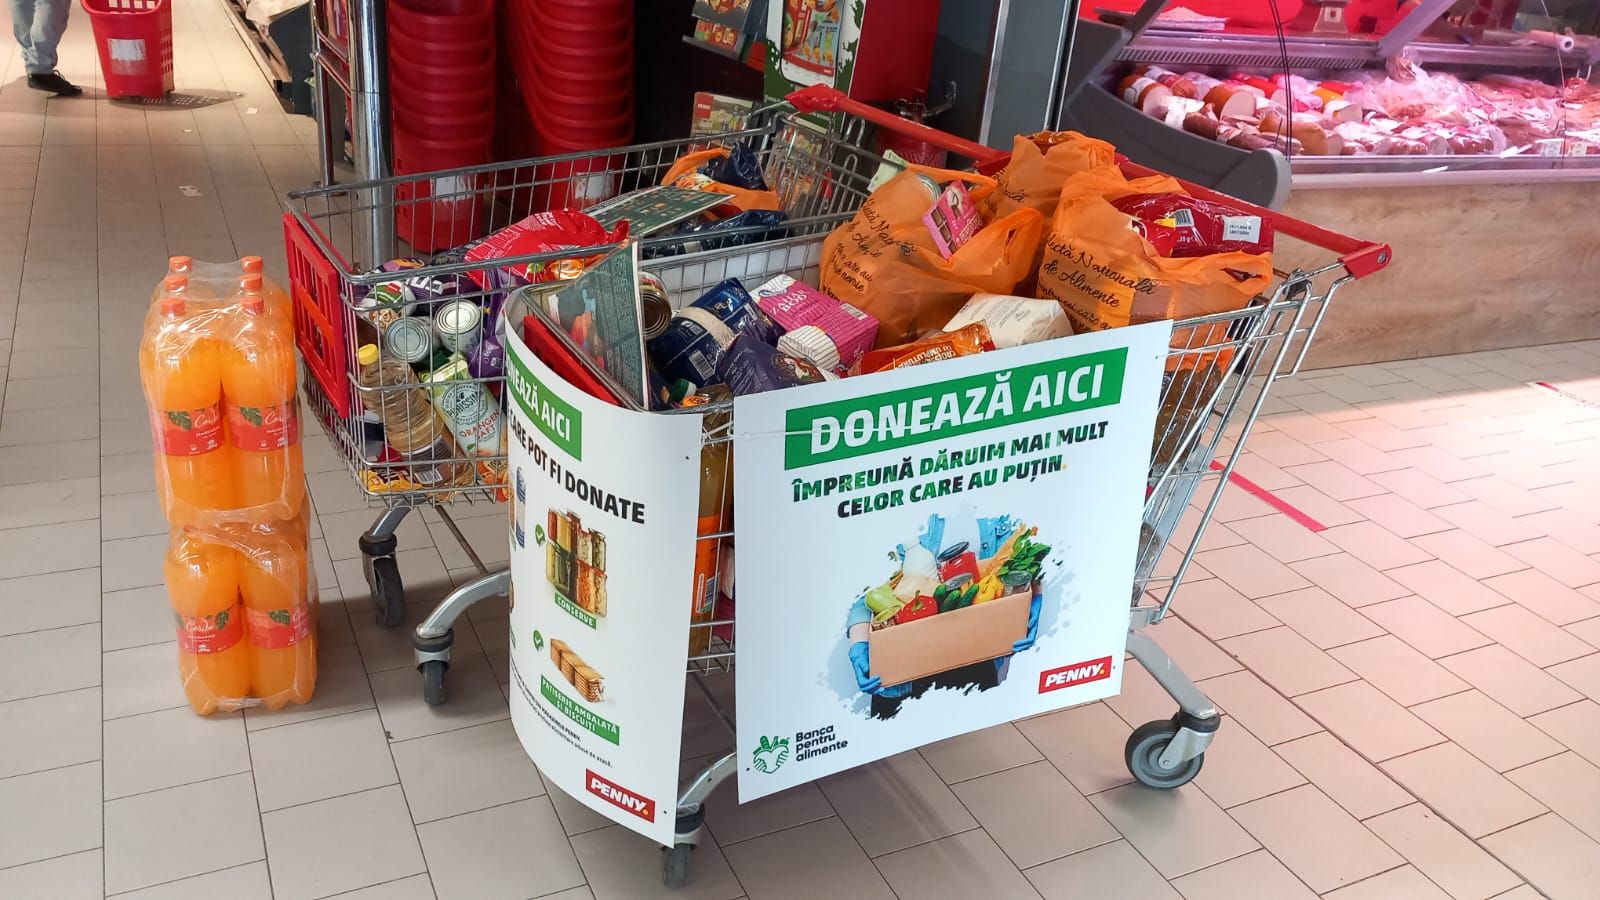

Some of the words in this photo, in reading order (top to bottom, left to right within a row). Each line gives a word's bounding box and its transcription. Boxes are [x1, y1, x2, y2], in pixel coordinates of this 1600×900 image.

[1043, 259, 1059, 275] de
[1058, 271, 1120, 307] Alimente
[541, 399, 571, 442] AICI
[810, 371, 1014, 456] DONEAZĂ
[1022, 363, 1105, 413] AICI
[528, 437, 548, 472] POT
[550, 457, 561, 484] FI
[565, 470, 646, 525] DONATE
[791, 457, 914, 503] ÎMPREUNĂ
[919, 442, 1006, 476] DĂRUIM
[1010, 432, 1051, 457] MAI
[1057, 421, 1109, 447] MULT
[837, 489, 904, 519] CELOR
[909, 475, 964, 504] CARE
[967, 467, 999, 490] AU
[557, 596, 594, 626] CONSERVE
[542, 678, 573, 710] PATISERIE
[574, 705, 618, 735] AMBALATĂ
[795, 725, 834, 743] Banca
[795, 733, 836, 754] pentru
[795, 740, 849, 762] alimente
